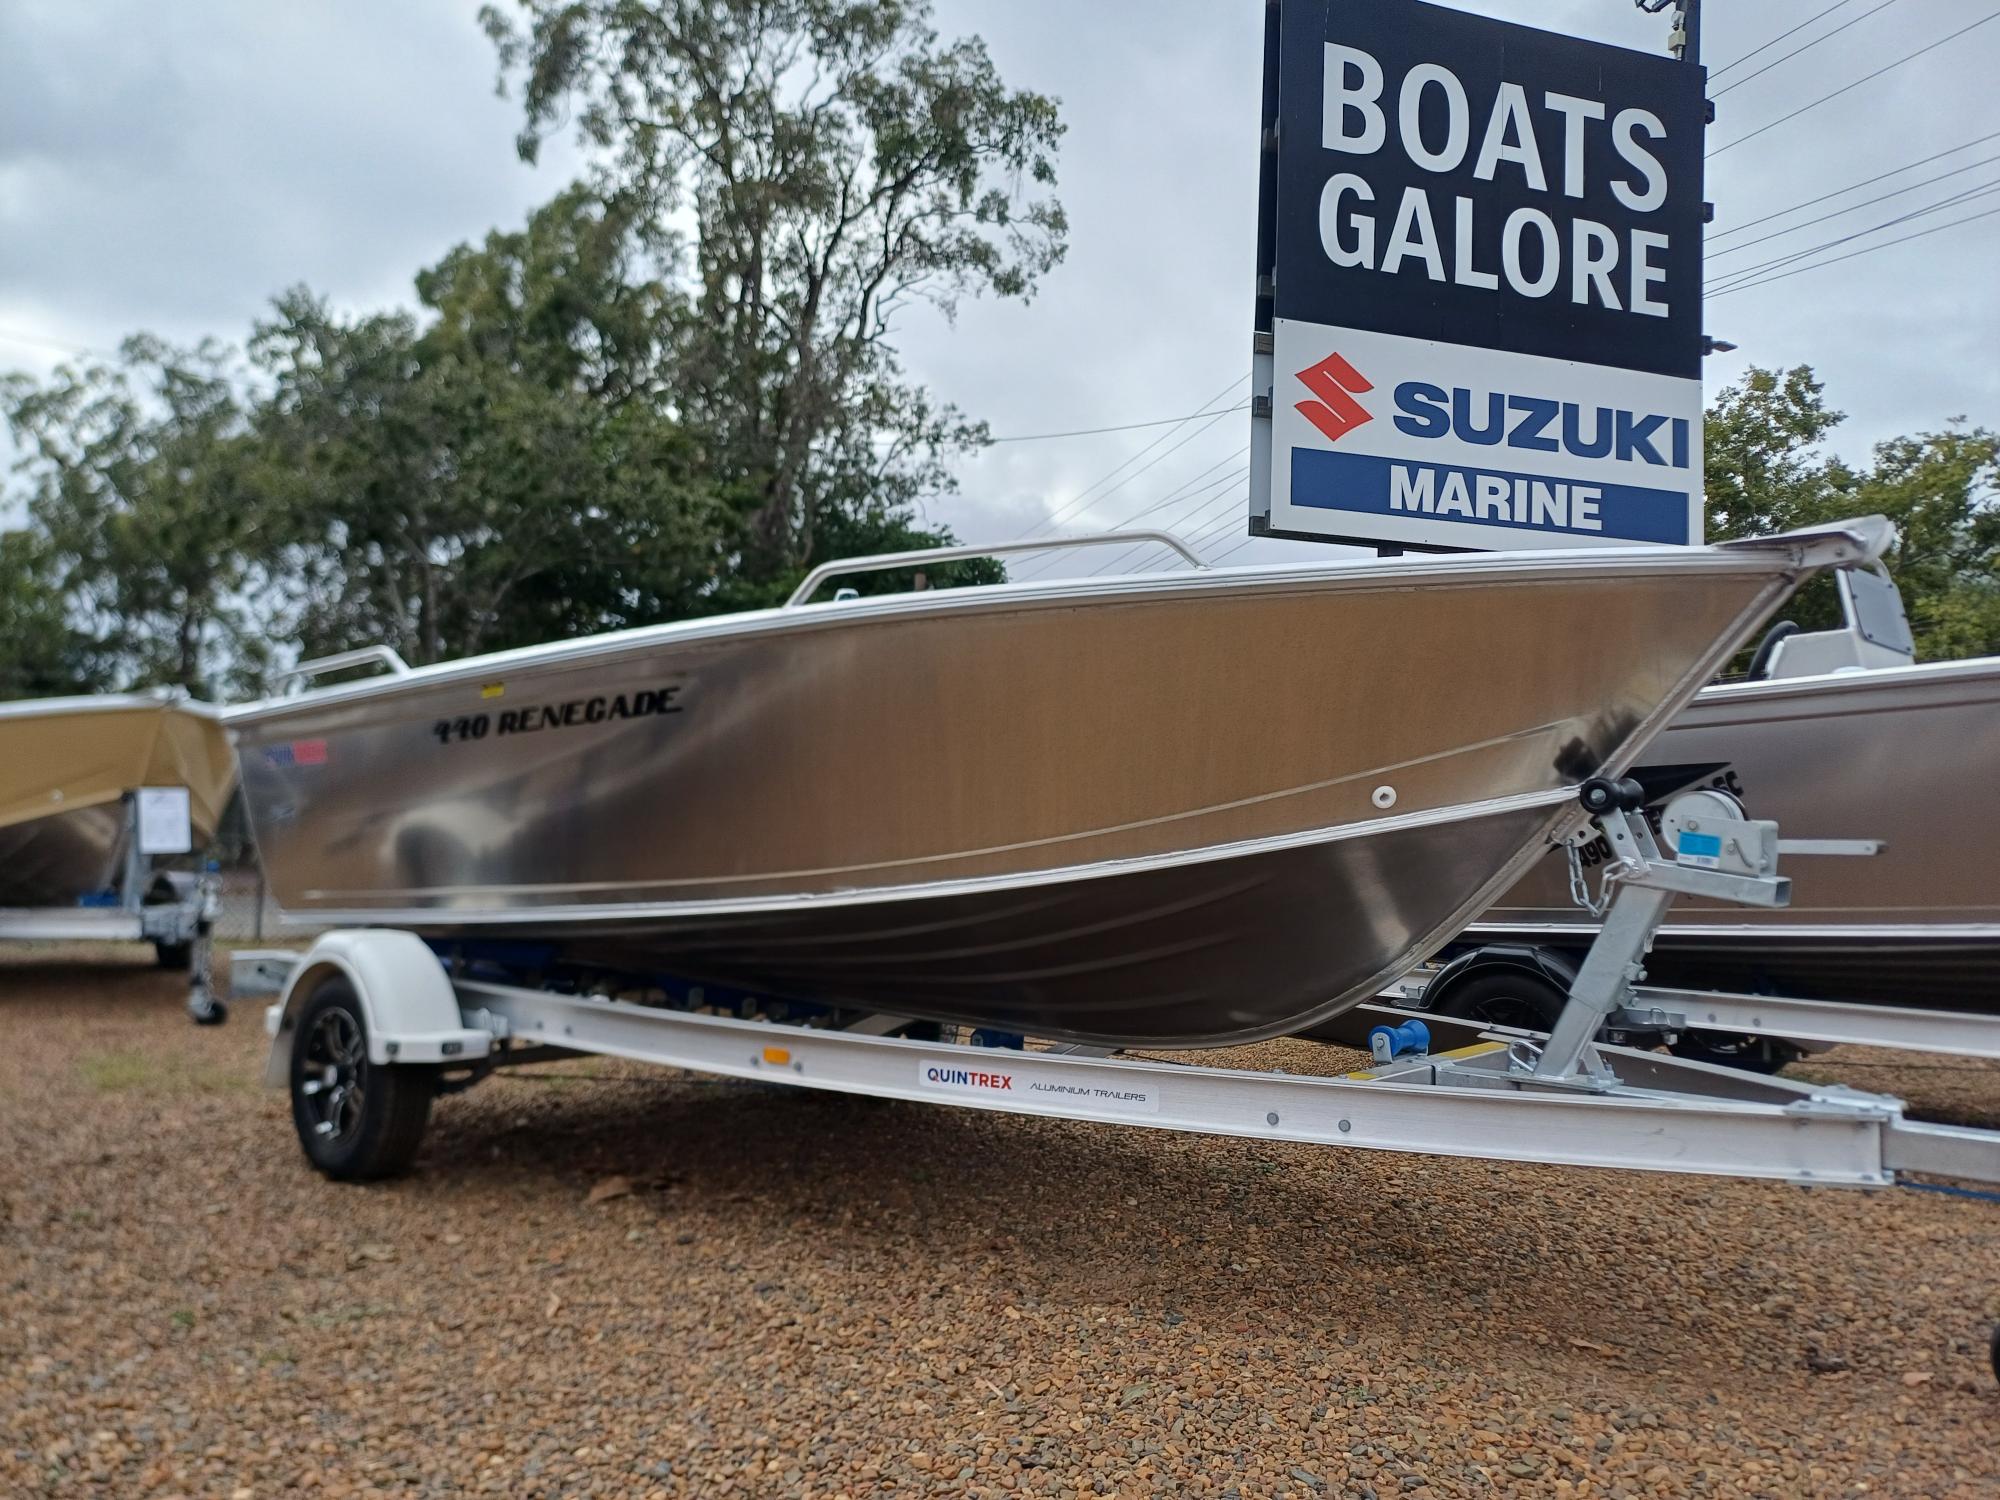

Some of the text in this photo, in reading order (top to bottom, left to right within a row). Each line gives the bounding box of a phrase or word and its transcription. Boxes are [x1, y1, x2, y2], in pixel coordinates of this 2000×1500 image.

[1322, 41, 1668, 213] BOATS
[1319, 173, 1669, 318] GALORE
[1393, 381, 1689, 469] SUZUKI
[1390, 465, 1602, 530] MARINE
[497, 686, 683, 736] RENEGADE
[927, 1067, 1147, 1102] QUINTREX ALUMINIUM TRAILERS
